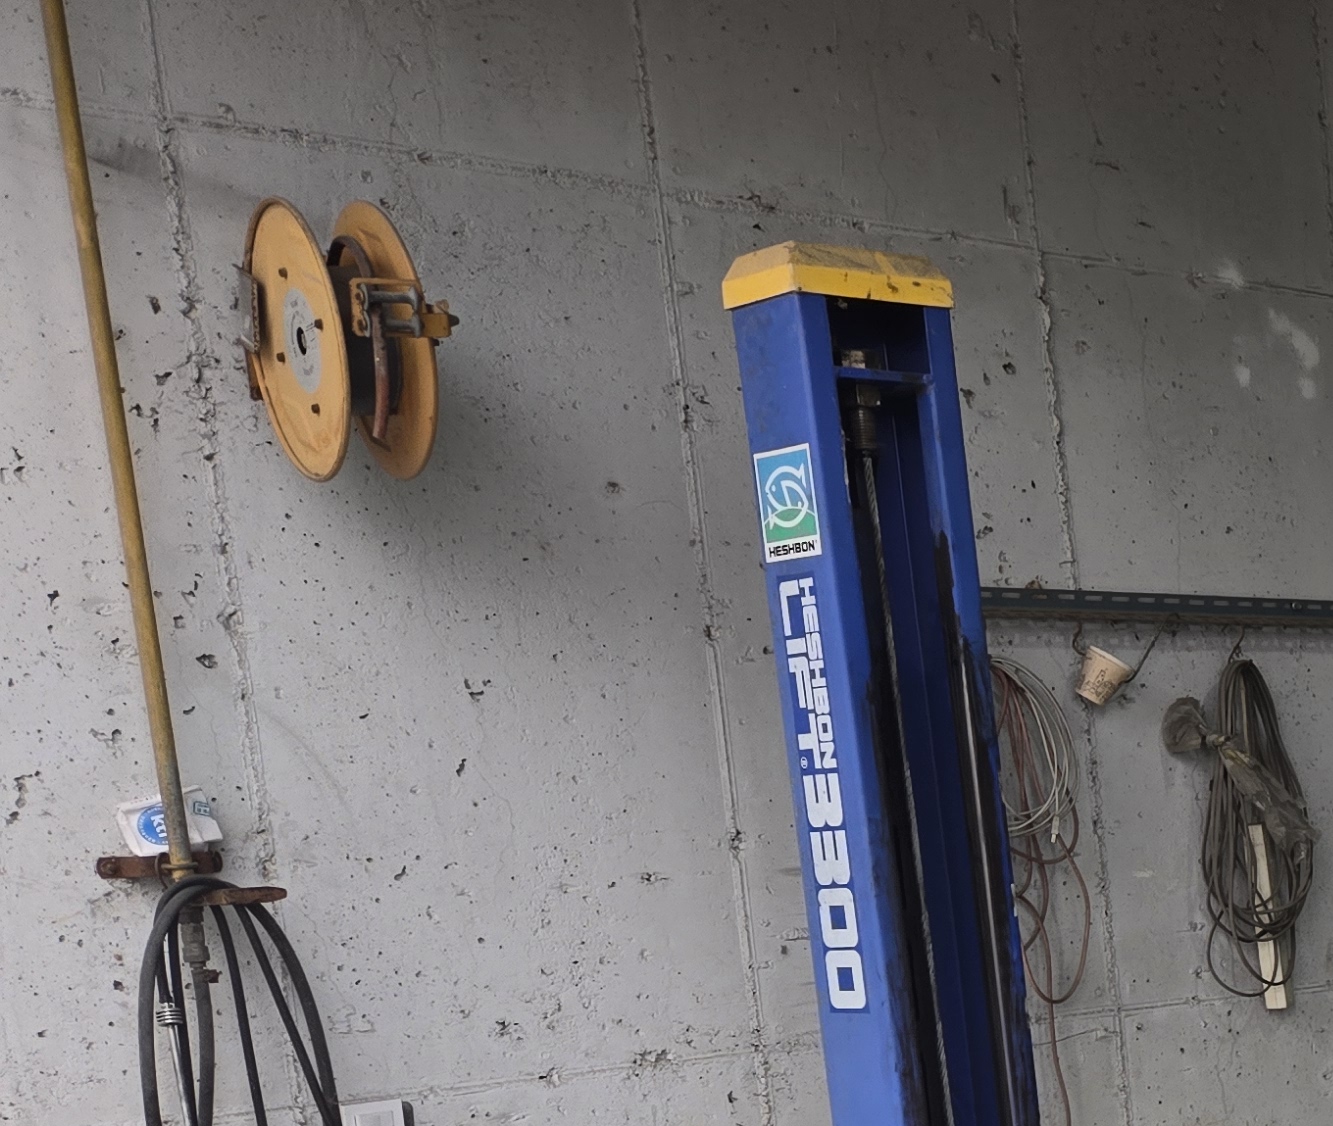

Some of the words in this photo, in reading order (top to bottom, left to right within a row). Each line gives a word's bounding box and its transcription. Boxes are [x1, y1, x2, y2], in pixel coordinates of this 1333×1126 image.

[768, 540, 815, 558] HESHBON
[778, 577, 822, 770] LIFT
[798, 577, 838, 770] HESHBON
[801, 772, 867, 1010] 3300
